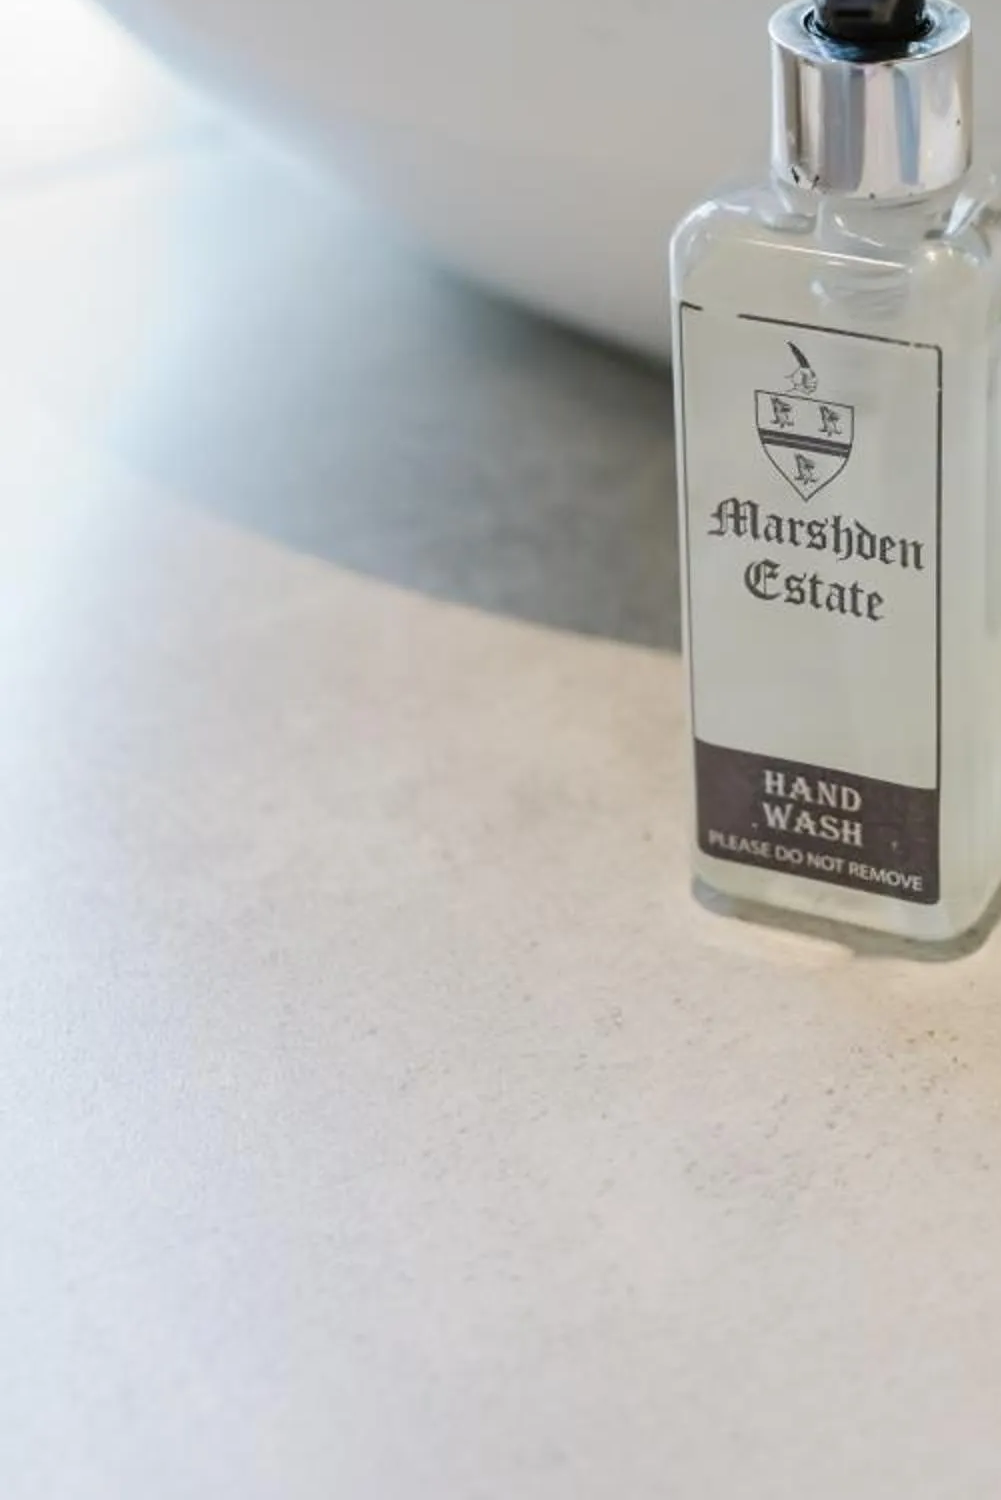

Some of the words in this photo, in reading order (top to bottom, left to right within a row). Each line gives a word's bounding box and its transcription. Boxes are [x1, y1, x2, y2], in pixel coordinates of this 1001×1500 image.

[707, 496, 925, 570] Marshden
[743, 558, 885, 621] Estate
[763, 769, 863, 813] HAND
[762, 802, 863, 847] WASH
[708, 829, 770, 856] PLEASE
[775, 845, 804, 864] DO
[807, 853, 845, 873] NOT
[849, 861, 923, 892] REMOVE
